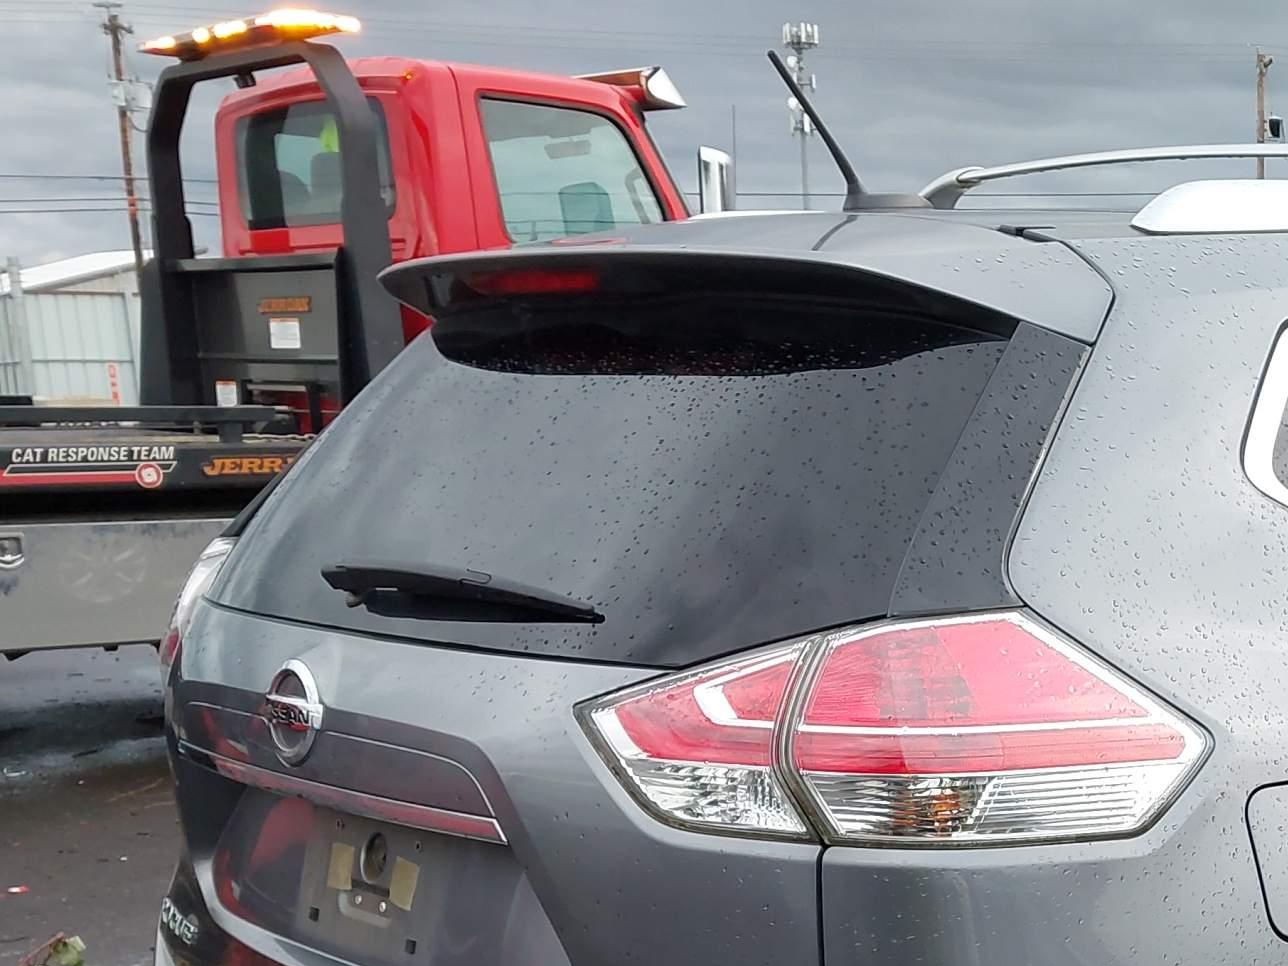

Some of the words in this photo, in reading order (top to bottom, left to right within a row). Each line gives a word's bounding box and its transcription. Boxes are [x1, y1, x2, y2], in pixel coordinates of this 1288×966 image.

[11, 448, 42, 463] CAT
[48, 447, 128, 462] RESPONSE
[131, 446, 175, 460] TEAM
[202, 456, 296, 476] JERR
